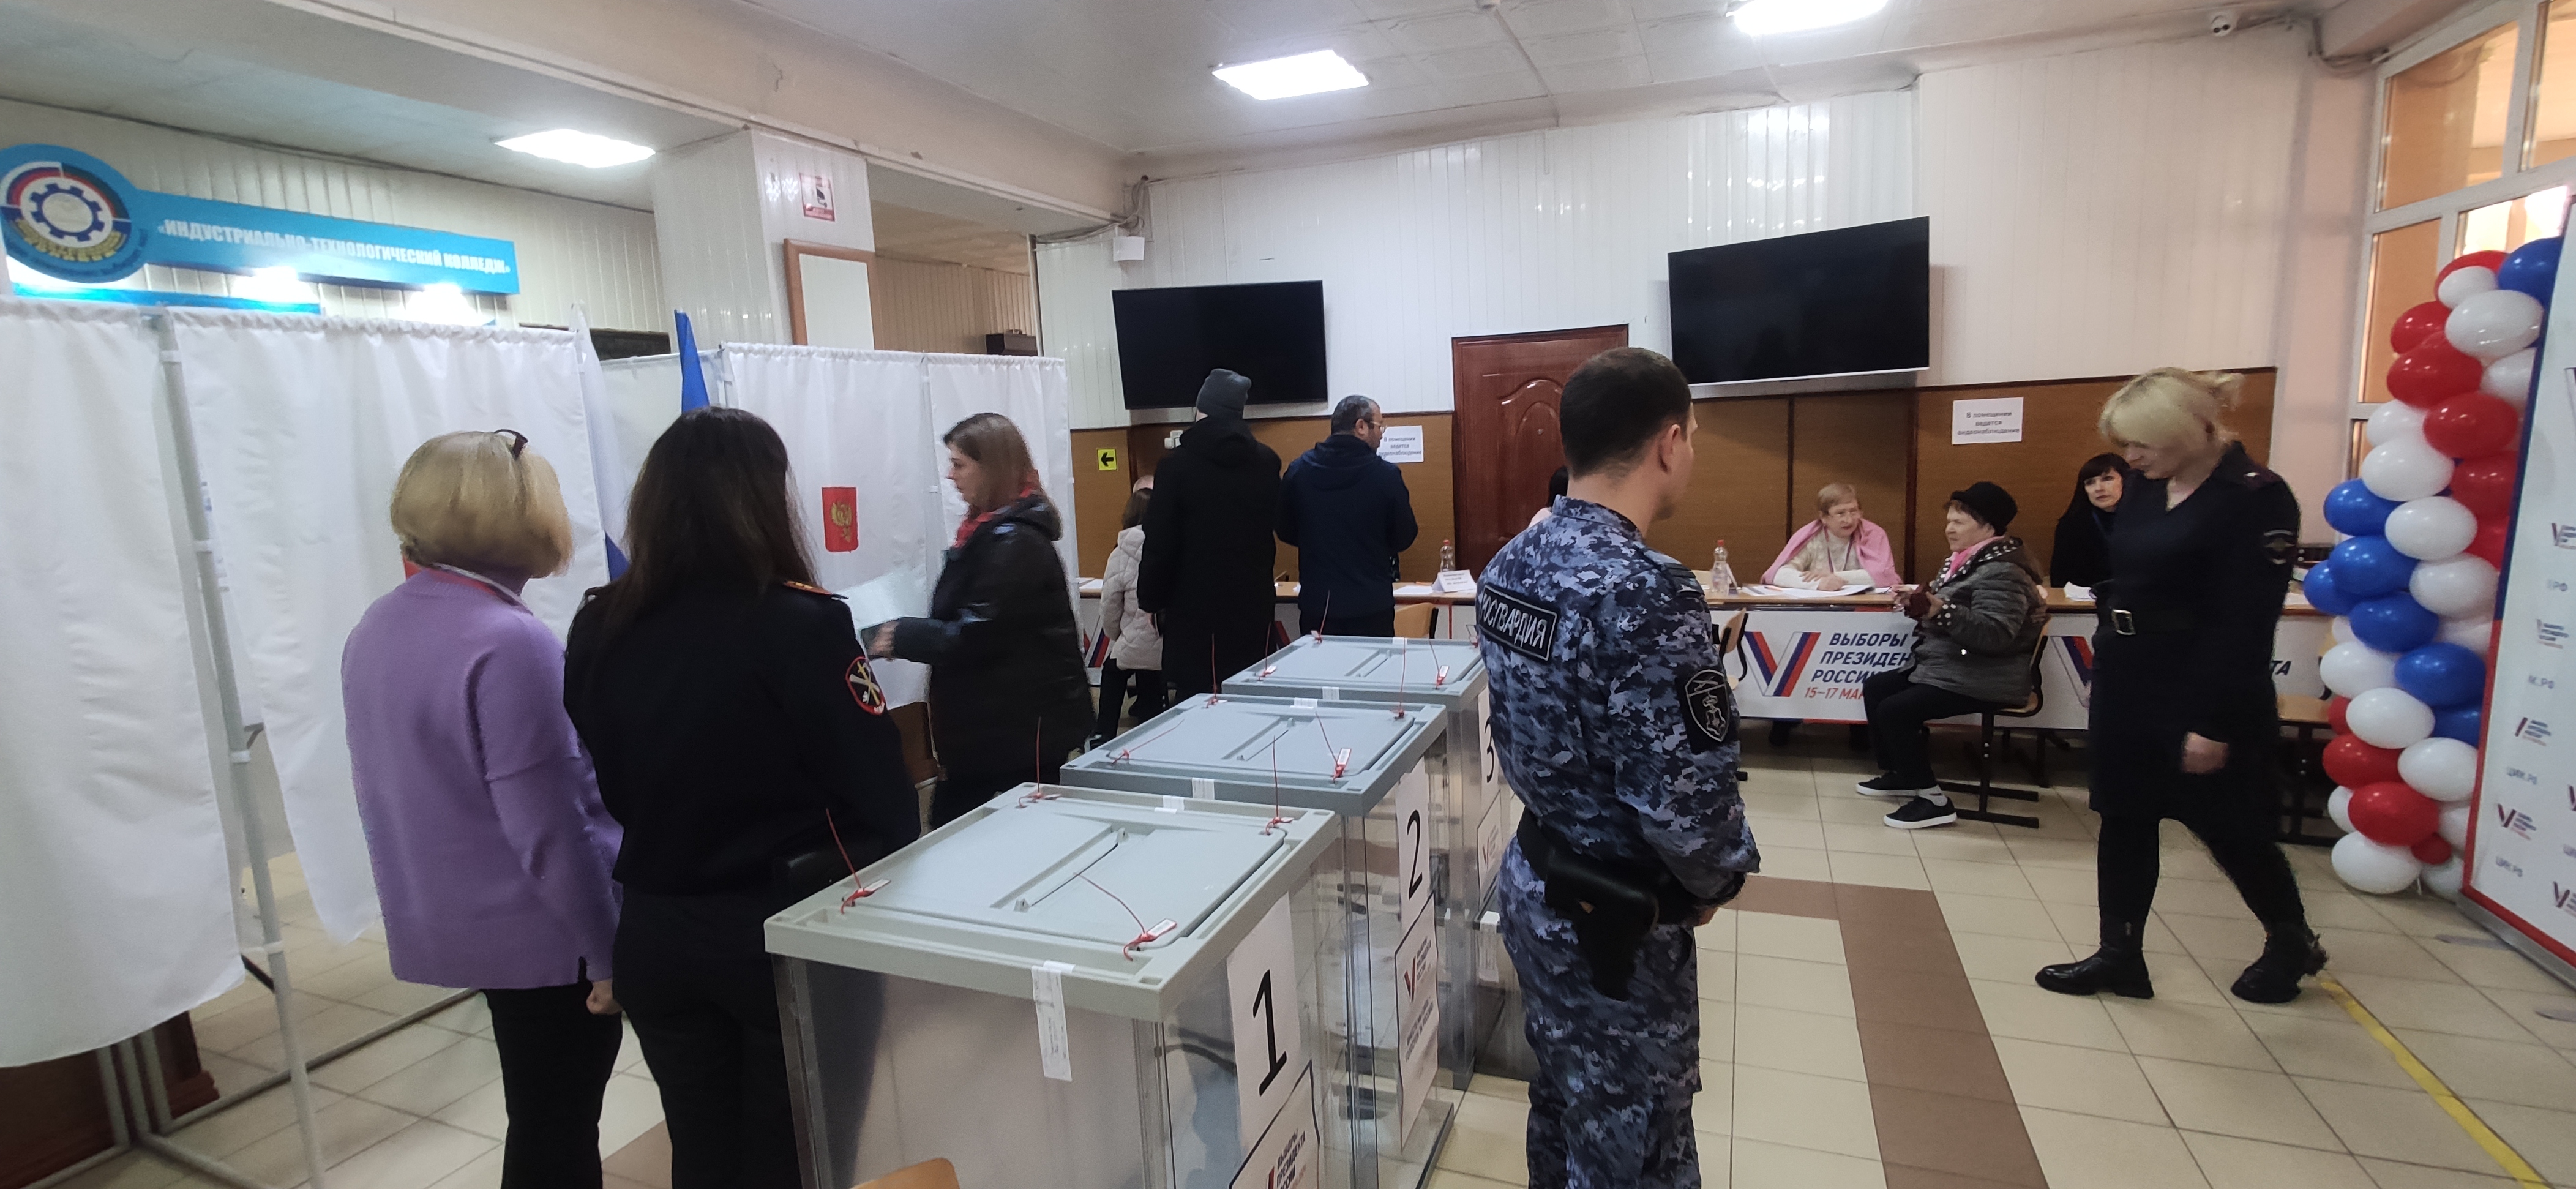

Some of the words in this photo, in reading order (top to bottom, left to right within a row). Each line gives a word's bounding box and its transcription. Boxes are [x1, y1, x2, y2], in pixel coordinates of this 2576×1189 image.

[444, 252, 511, 274] КОЛЛЕДЖ»
[1480, 593, 1548, 650] РОСГВАРДИЯ
[1829, 632, 1909, 647] ВЫБОРЫ
[1485, 715, 1494, 784] 3
[1407, 809, 1422, 900] 2
[1252, 969, 1287, 1097] 1
[1276, 1130, 1306, 1189] ПРЕЗИДЕНТА
